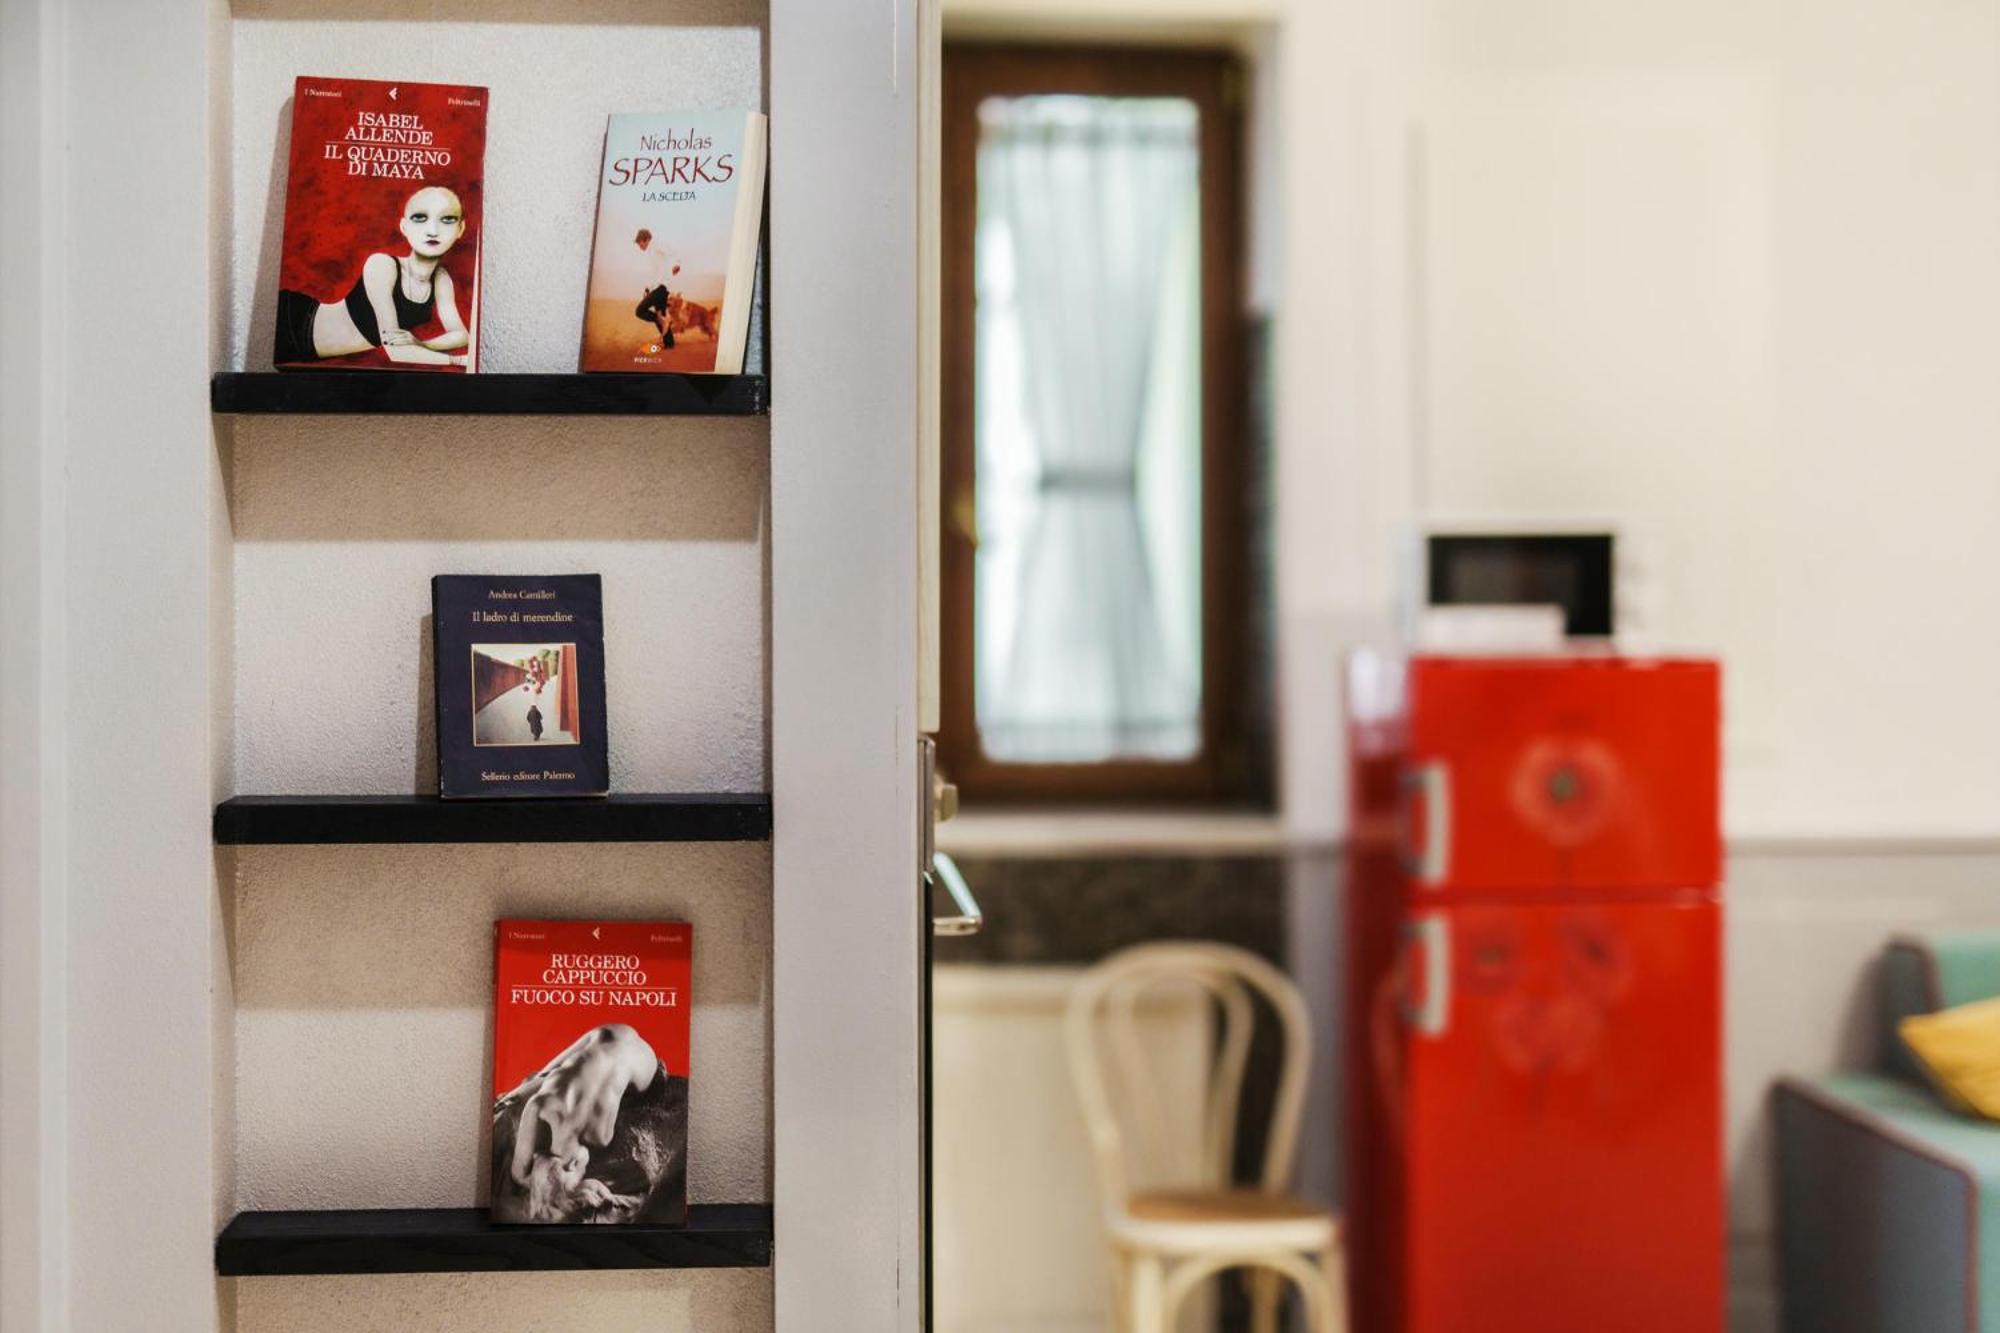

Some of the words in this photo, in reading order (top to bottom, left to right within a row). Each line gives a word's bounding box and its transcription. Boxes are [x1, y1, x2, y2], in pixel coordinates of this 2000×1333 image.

[357, 112, 423, 130] ISABEL
[345, 127, 433, 145] ALLENDE
[640, 128, 712, 151] Nicholas
[324, 145, 343, 160] IL
[347, 147, 451, 166] QUADERNO
[348, 160, 367, 176] DI
[371, 163, 425, 180] MAYA
[608, 154, 734, 186] SPARKS
[642, 192, 656, 202] LA
[658, 191, 697, 202] SCELTA
[488, 590, 518, 600] Andrea
[519, 589, 556, 600] Camilleri
[472, 611, 480, 622] Il
[483, 610, 508, 622] ladro
[510, 611, 520, 622] di
[523, 611, 573, 622] merendine
[481, 771, 511, 782] Sellerio
[512, 770, 541, 781] editore
[543, 770, 576, 781] Palermo
[551, 954, 640, 970] RUGGERO
[542, 969, 647, 986] CAPPUCCIO
[511, 988, 575, 1005] FUOCO
[579, 990, 604, 1006] SU
[608, 991, 677, 1007] NAPOLI
